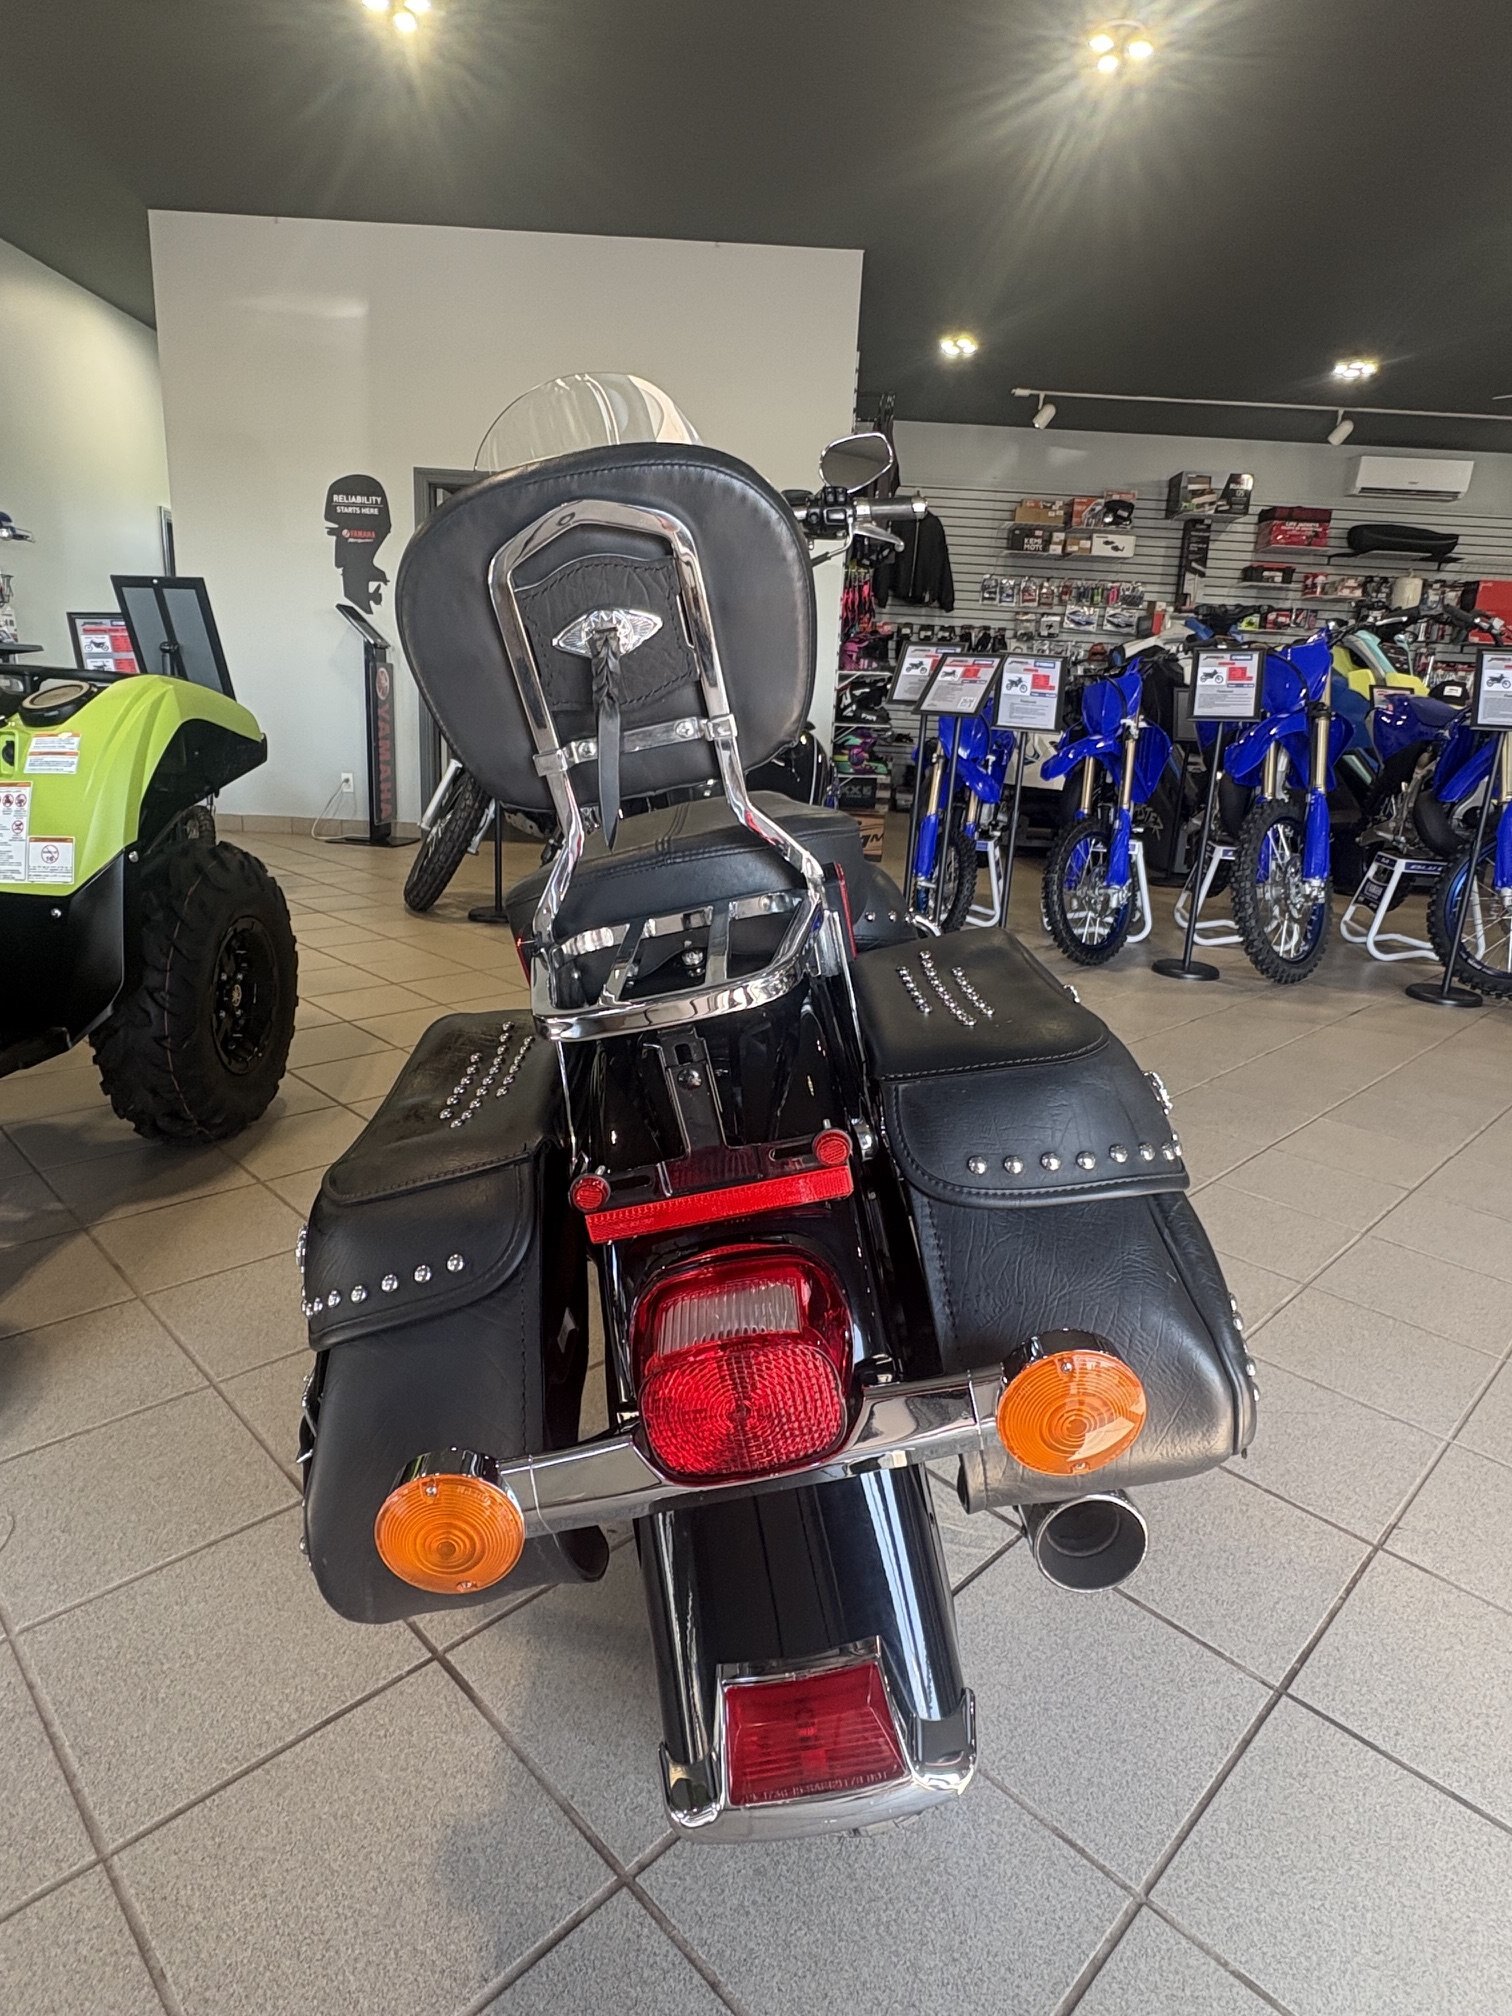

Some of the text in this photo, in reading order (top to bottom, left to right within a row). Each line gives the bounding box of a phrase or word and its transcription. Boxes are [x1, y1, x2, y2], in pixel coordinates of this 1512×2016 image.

[333, 494, 382, 504] RELIABILITY
[336, 506, 379, 515] STARTS HERE
[350, 529, 376, 538] YAMAHA
[377, 703, 393, 820] YAMAHA
